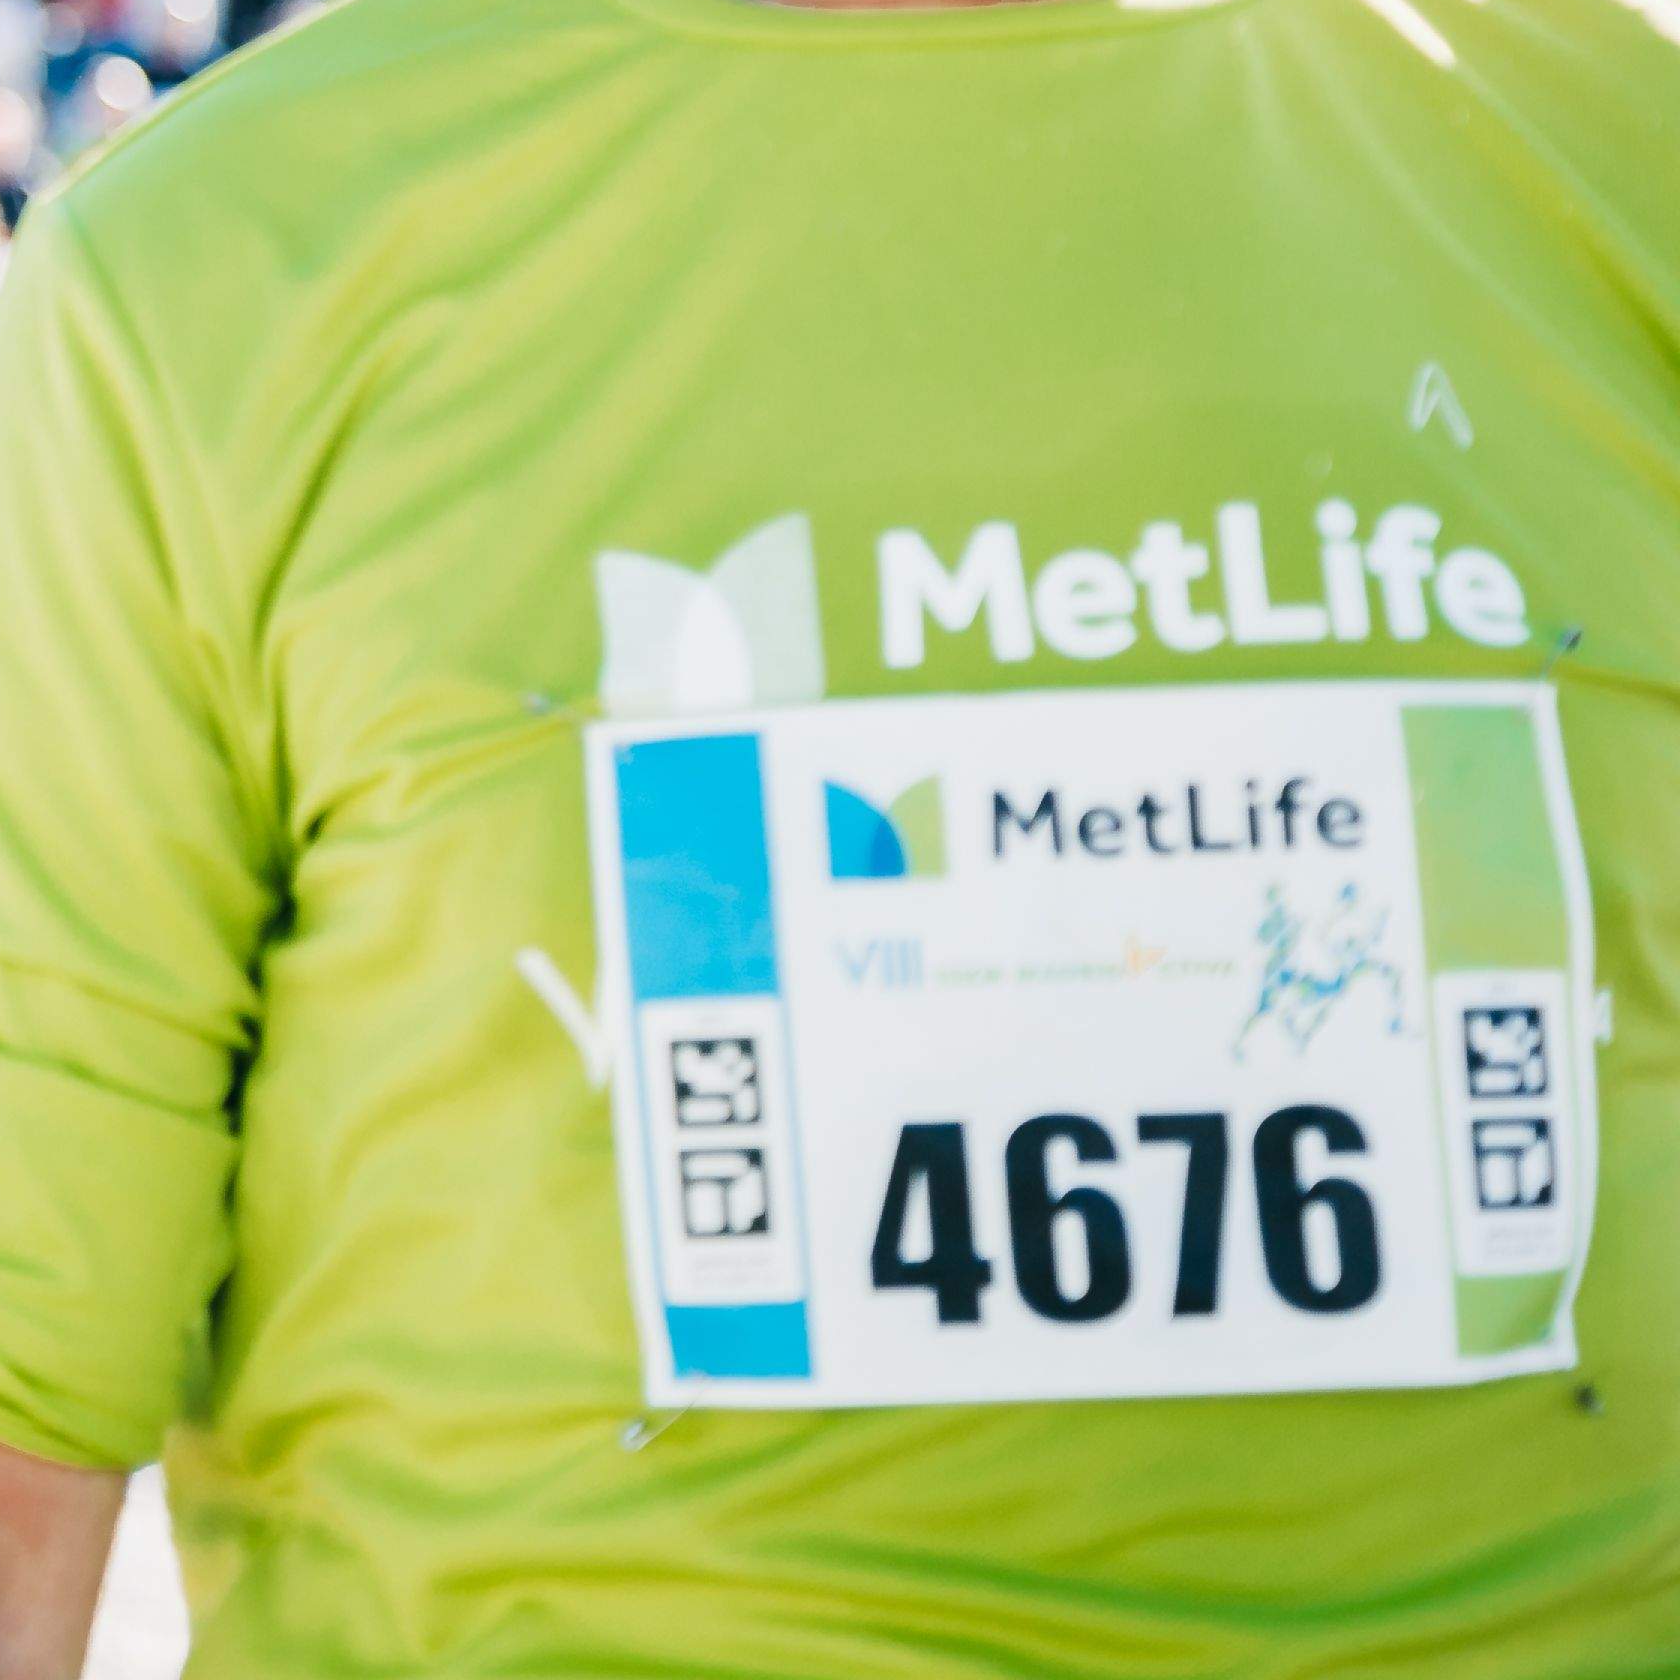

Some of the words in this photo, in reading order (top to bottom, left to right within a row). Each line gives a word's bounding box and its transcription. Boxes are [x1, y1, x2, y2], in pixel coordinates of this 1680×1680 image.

[874, 498, 1532, 671] MetLife
[988, 776, 1368, 860] MetLife
[869, 1103, 1383, 1325] 4676
